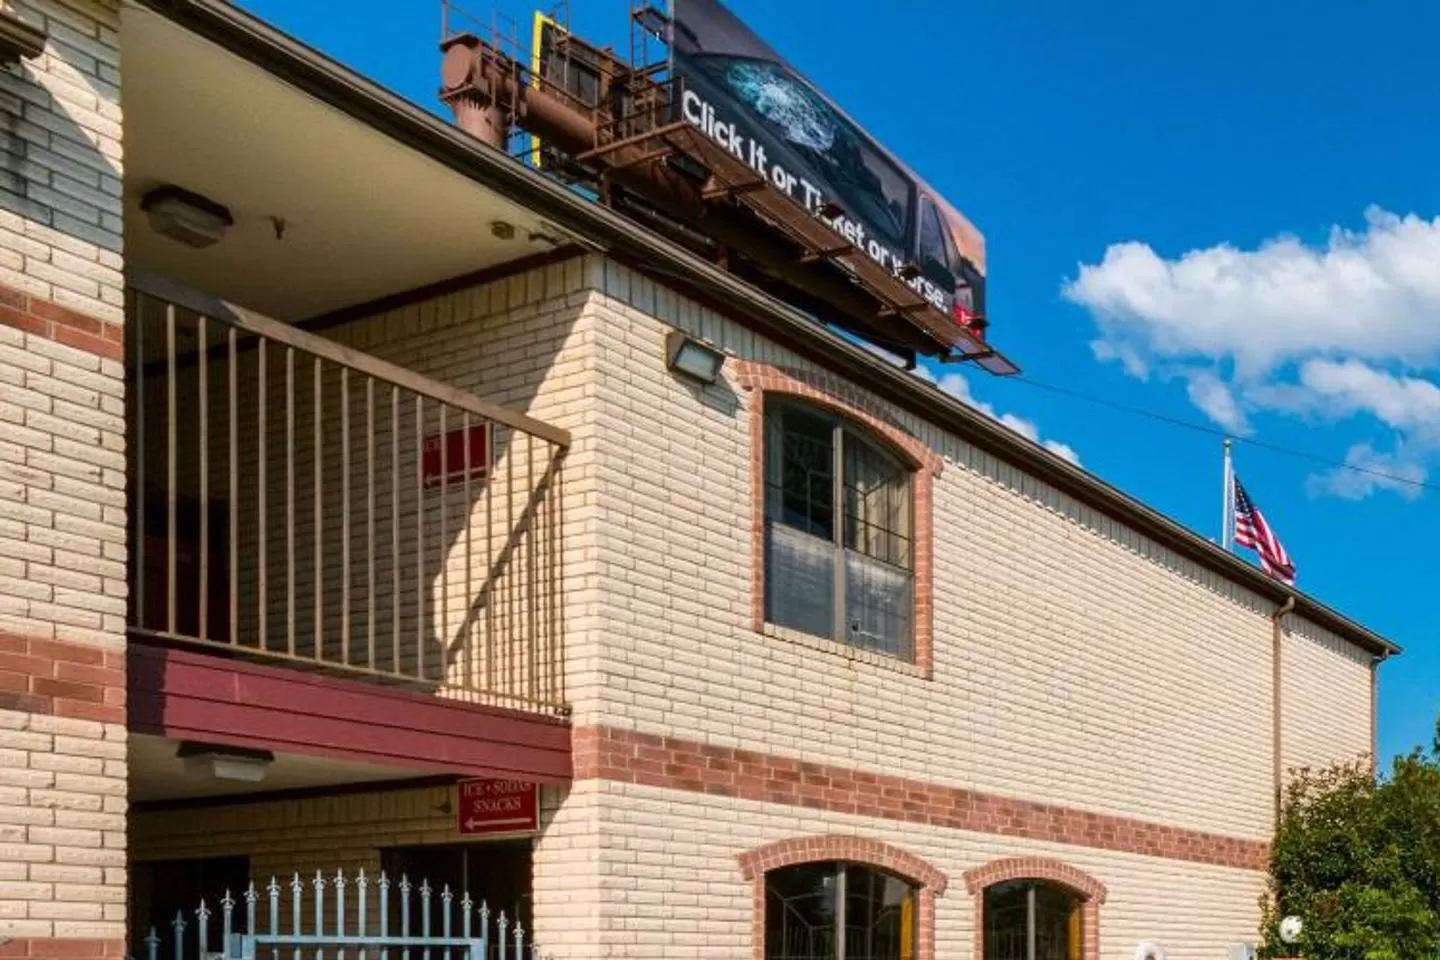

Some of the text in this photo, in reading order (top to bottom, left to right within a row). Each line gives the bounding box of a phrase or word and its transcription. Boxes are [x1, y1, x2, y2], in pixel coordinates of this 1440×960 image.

[682, 90, 744, 160] Click
[749, 138, 768, 181] It
[772, 164, 797, 196] or
[868, 239, 890, 268] or
[463, 782, 485, 797] ICE
[473, 796, 522, 813] SNACKS
